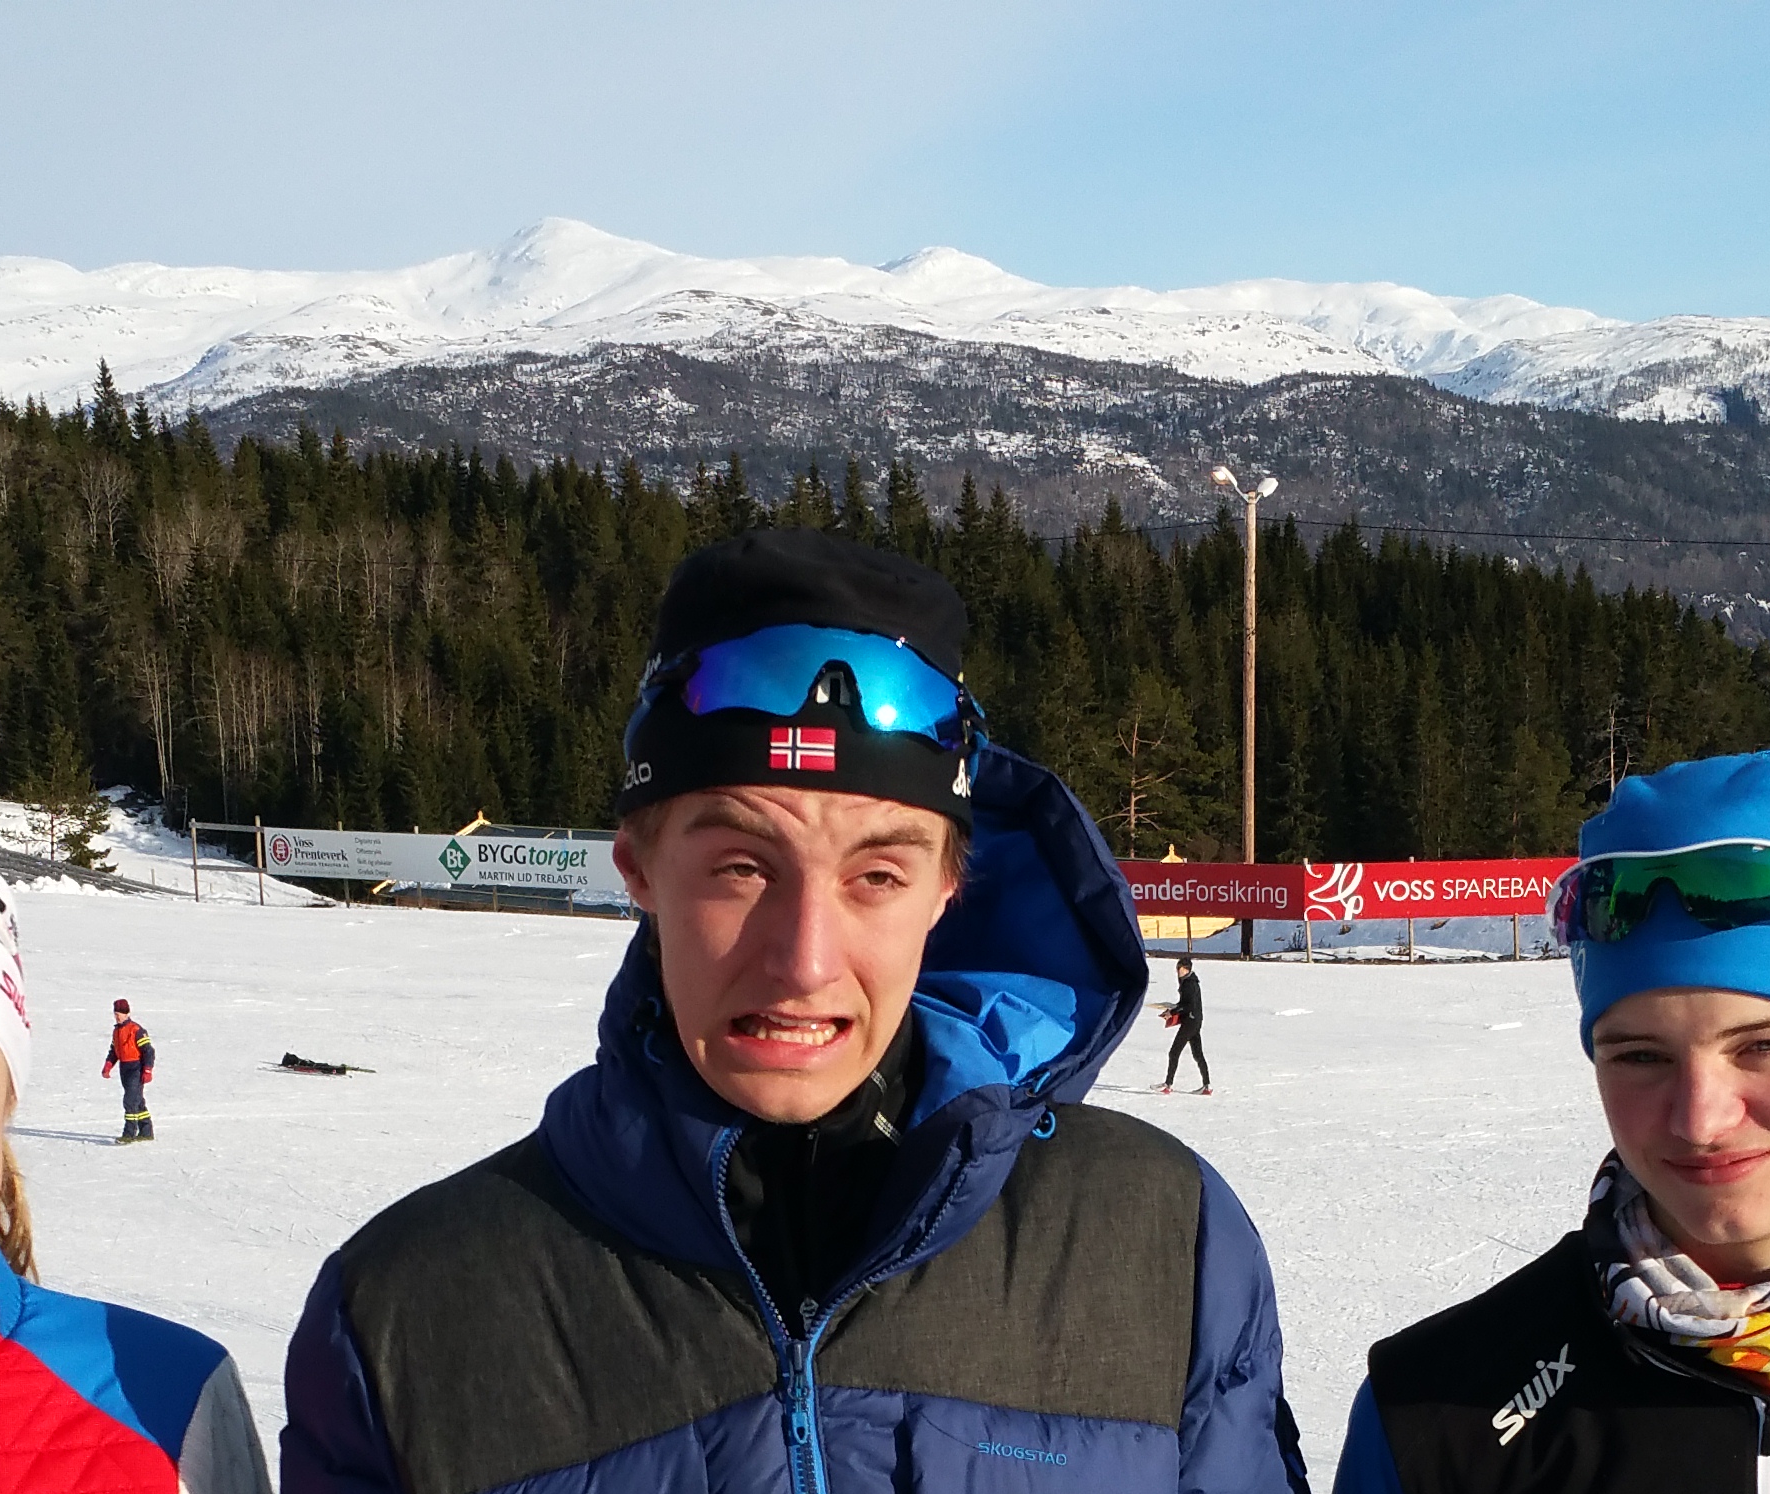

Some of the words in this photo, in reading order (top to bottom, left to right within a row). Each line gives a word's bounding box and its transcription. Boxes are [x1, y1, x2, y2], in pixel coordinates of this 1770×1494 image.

[293, 836, 314, 848] Voss
[294, 849, 349, 862] Prenteverk
[478, 844, 588, 871] BYGGtorget
[479, 871, 515, 882] MARTIN
[518, 873, 532, 883] LID
[536, 874, 573, 885] TRELAST
[576, 876, 588, 885] AS
[1374, 880, 1435, 901] VOSS
[1442, 877, 1556, 900] SPAREBAN
[1128, 879, 1288, 909] endeForsikring
[979, 1442, 1067, 1466] SKOGSTAD
